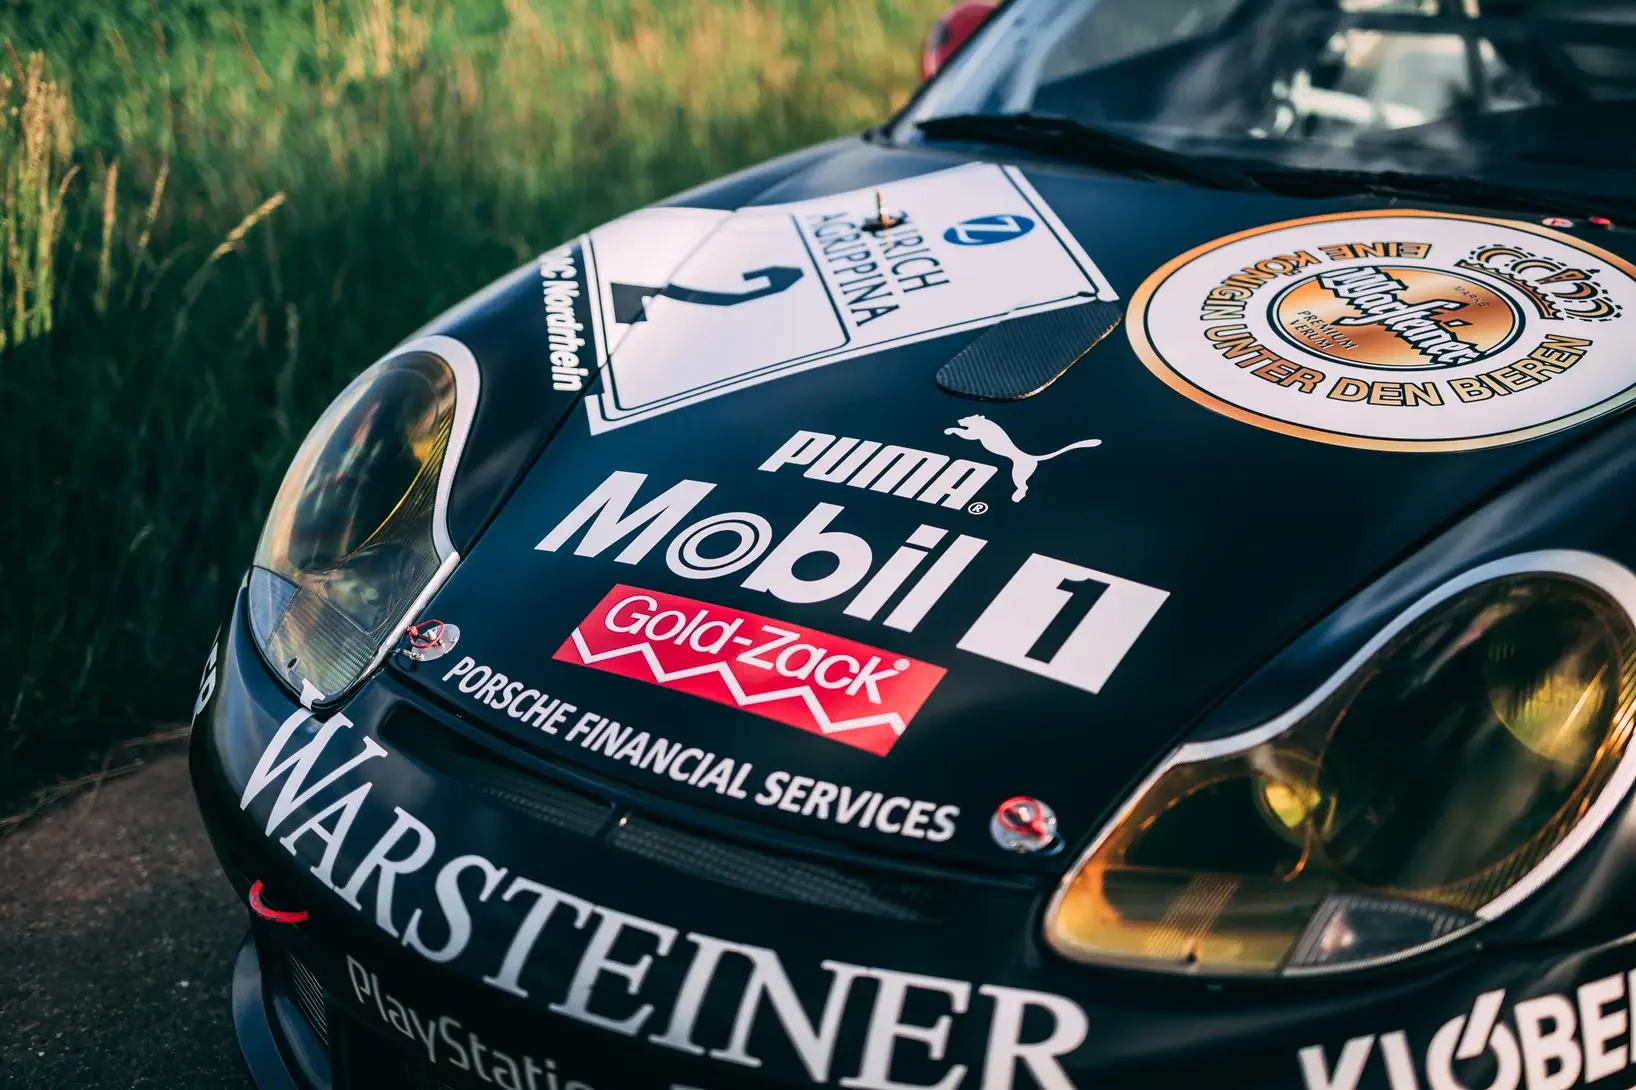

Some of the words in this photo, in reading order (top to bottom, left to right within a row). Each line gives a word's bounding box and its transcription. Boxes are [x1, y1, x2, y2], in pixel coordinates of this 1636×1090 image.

[807, 212, 899, 327] AGRIPPINA
[1200, 250, 1322, 321] KÖNIGIN
[1318, 242, 1432, 261] EINE
[610, 266, 804, 325] 2
[1296, 310, 1359, 350] PREMIUM
[542, 280, 589, 391] Nordrhein
[1203, 324, 1326, 394] UNTER
[1289, 319, 1334, 350] VERUM
[1449, 334, 1594, 403] BIEREN
[1326, 377, 1445, 407] DEN
[757, 430, 998, 511] PUMA
[534, 470, 988, 633] Mobil
[1025, 577, 1111, 665] 1
[603, 595, 904, 705] Gold-Zack
[442, 656, 578, 735] PORSCHE
[567, 714, 754, 801] FINANCIAL
[755, 769, 961, 843] SERVICES
[240, 679, 1090, 1090] WARSTEINER
